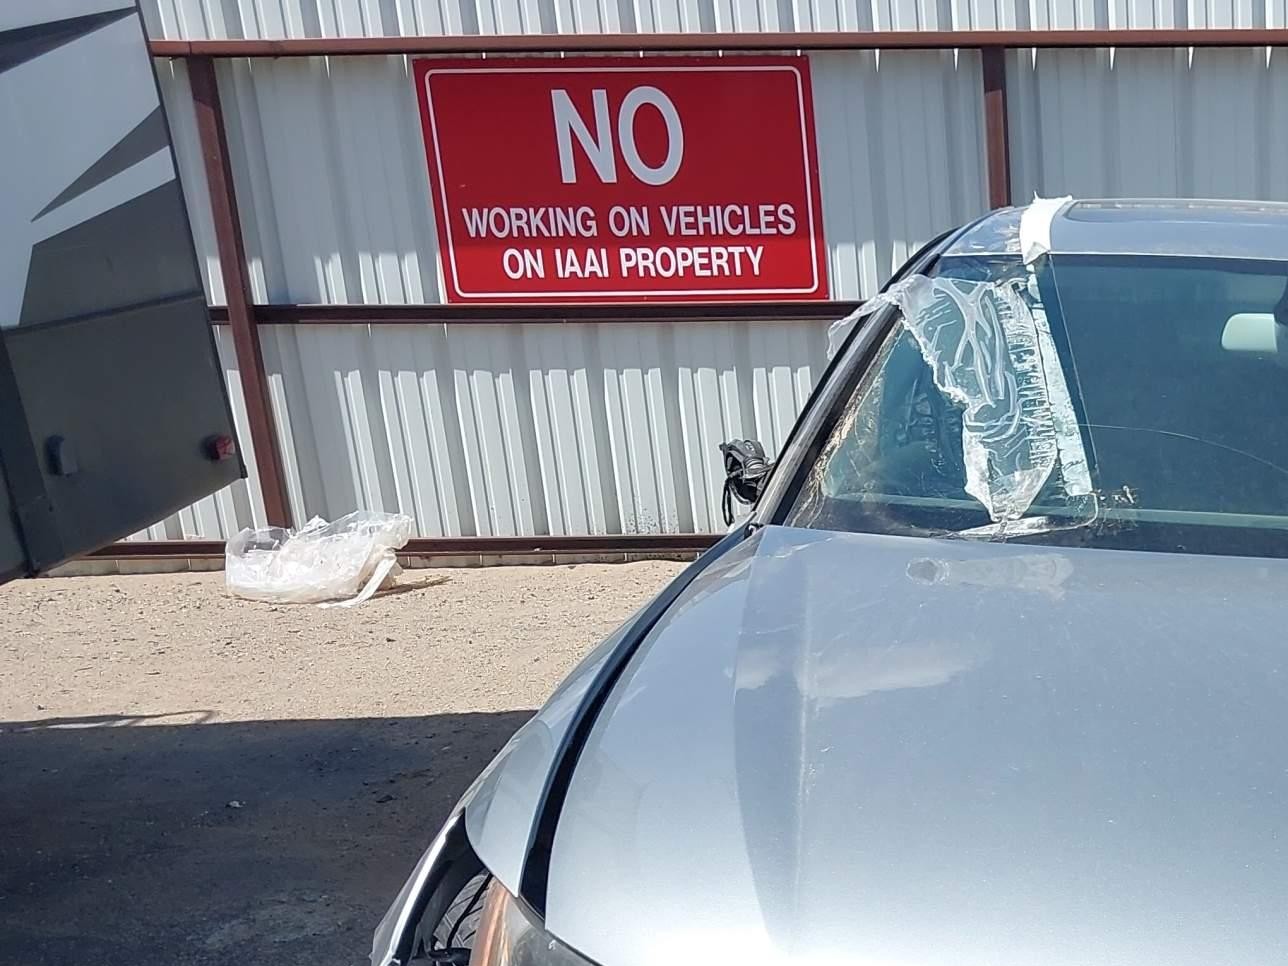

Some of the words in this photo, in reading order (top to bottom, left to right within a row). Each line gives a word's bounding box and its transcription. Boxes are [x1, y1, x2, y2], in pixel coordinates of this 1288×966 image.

[550, 85, 684, 186] NO
[462, 206, 598, 238] WORKING
[608, 205, 651, 237] ON
[661, 203, 798, 236] VEHICLES
[502, 247, 545, 279] ON
[555, 246, 609, 278] IAAI
[620, 245, 764, 278] PROPERTY
